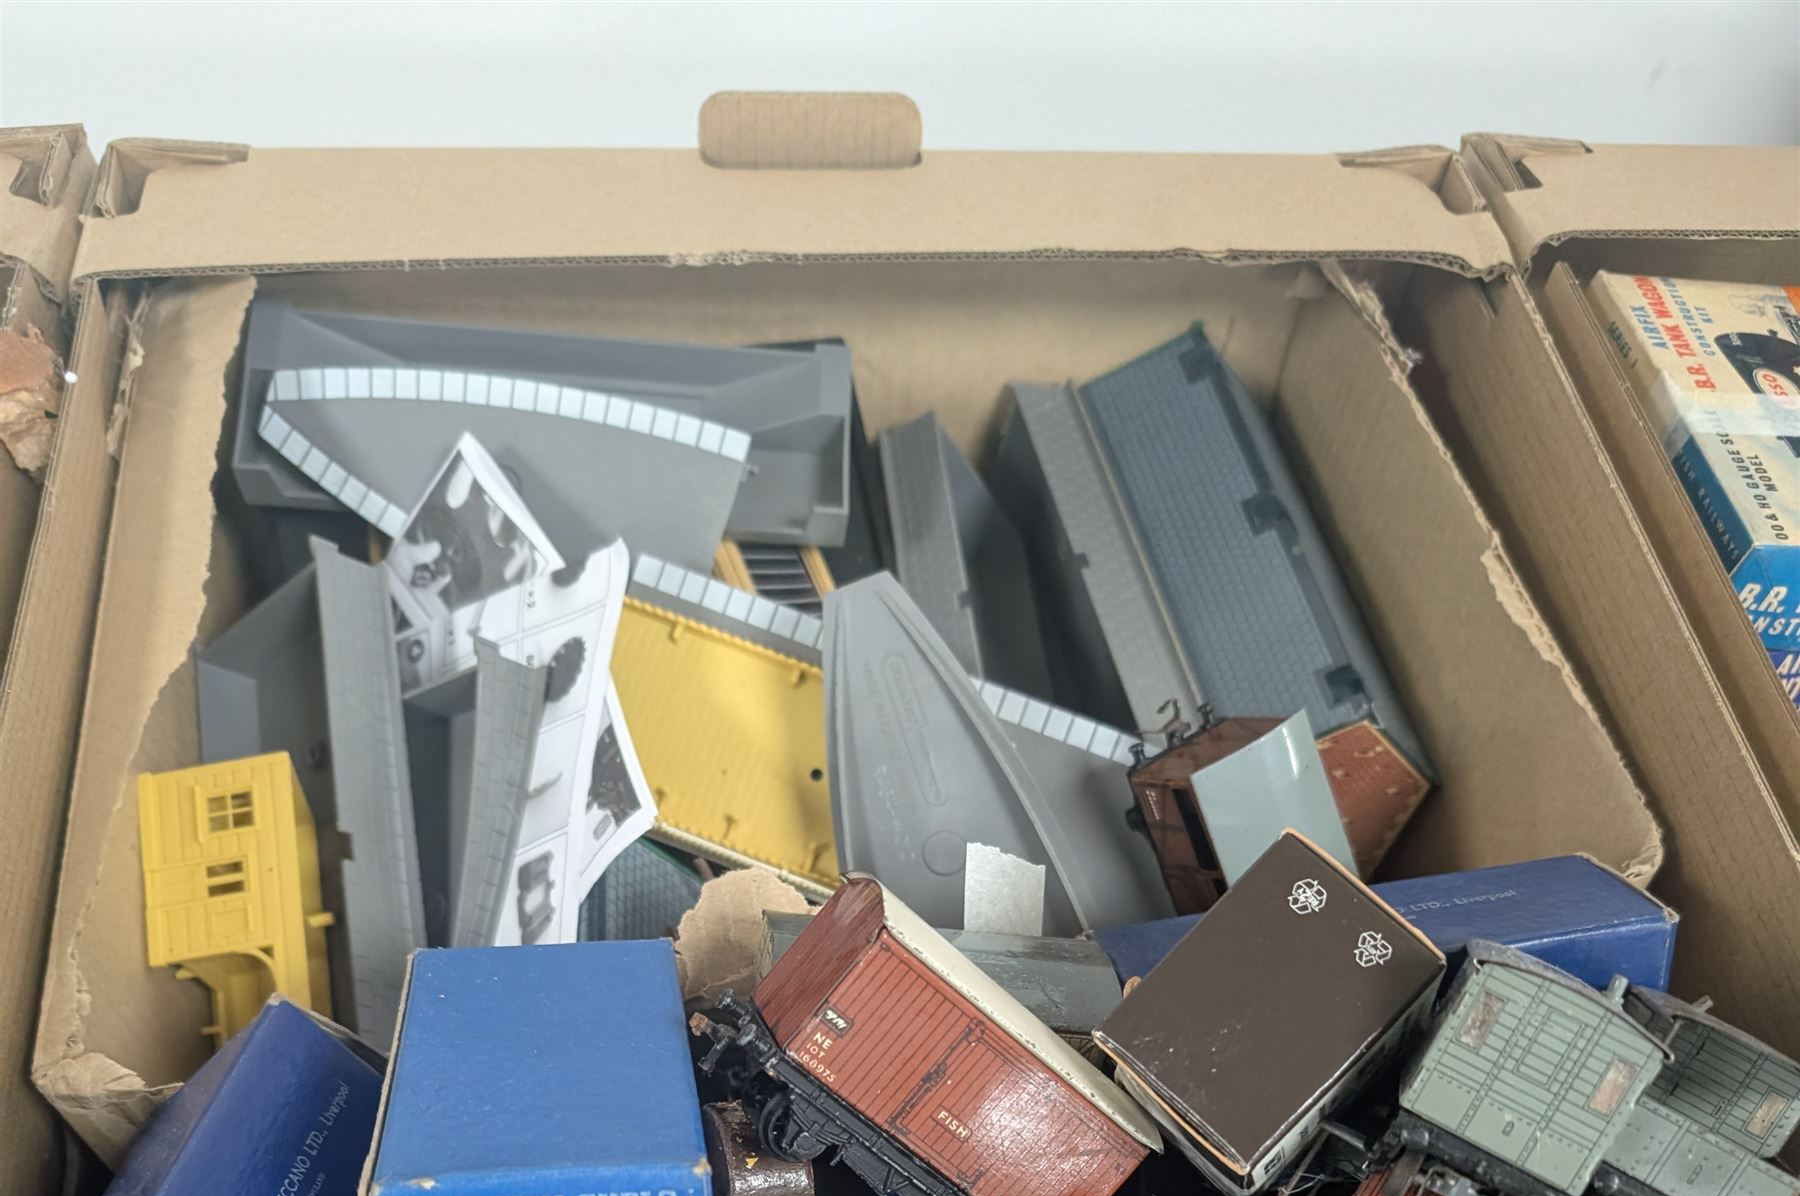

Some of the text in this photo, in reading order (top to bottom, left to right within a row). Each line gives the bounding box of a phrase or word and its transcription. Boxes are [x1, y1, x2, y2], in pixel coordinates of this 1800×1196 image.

[1632, 276, 1673, 319] WAGON
[1694, 306, 1713, 324] KIT
[1630, 305, 1669, 349] AIRFIX
[1661, 323, 1697, 358] TANK
[1727, 450, 1760, 490] GAUGE
[1747, 454, 1778, 493] MODEL
[1753, 494, 1771, 509] HO
[813, 1032, 833, 1050] NE
[319, 1081, 351, 1127] Liverpool
[937, 1110, 968, 1138] FISH
